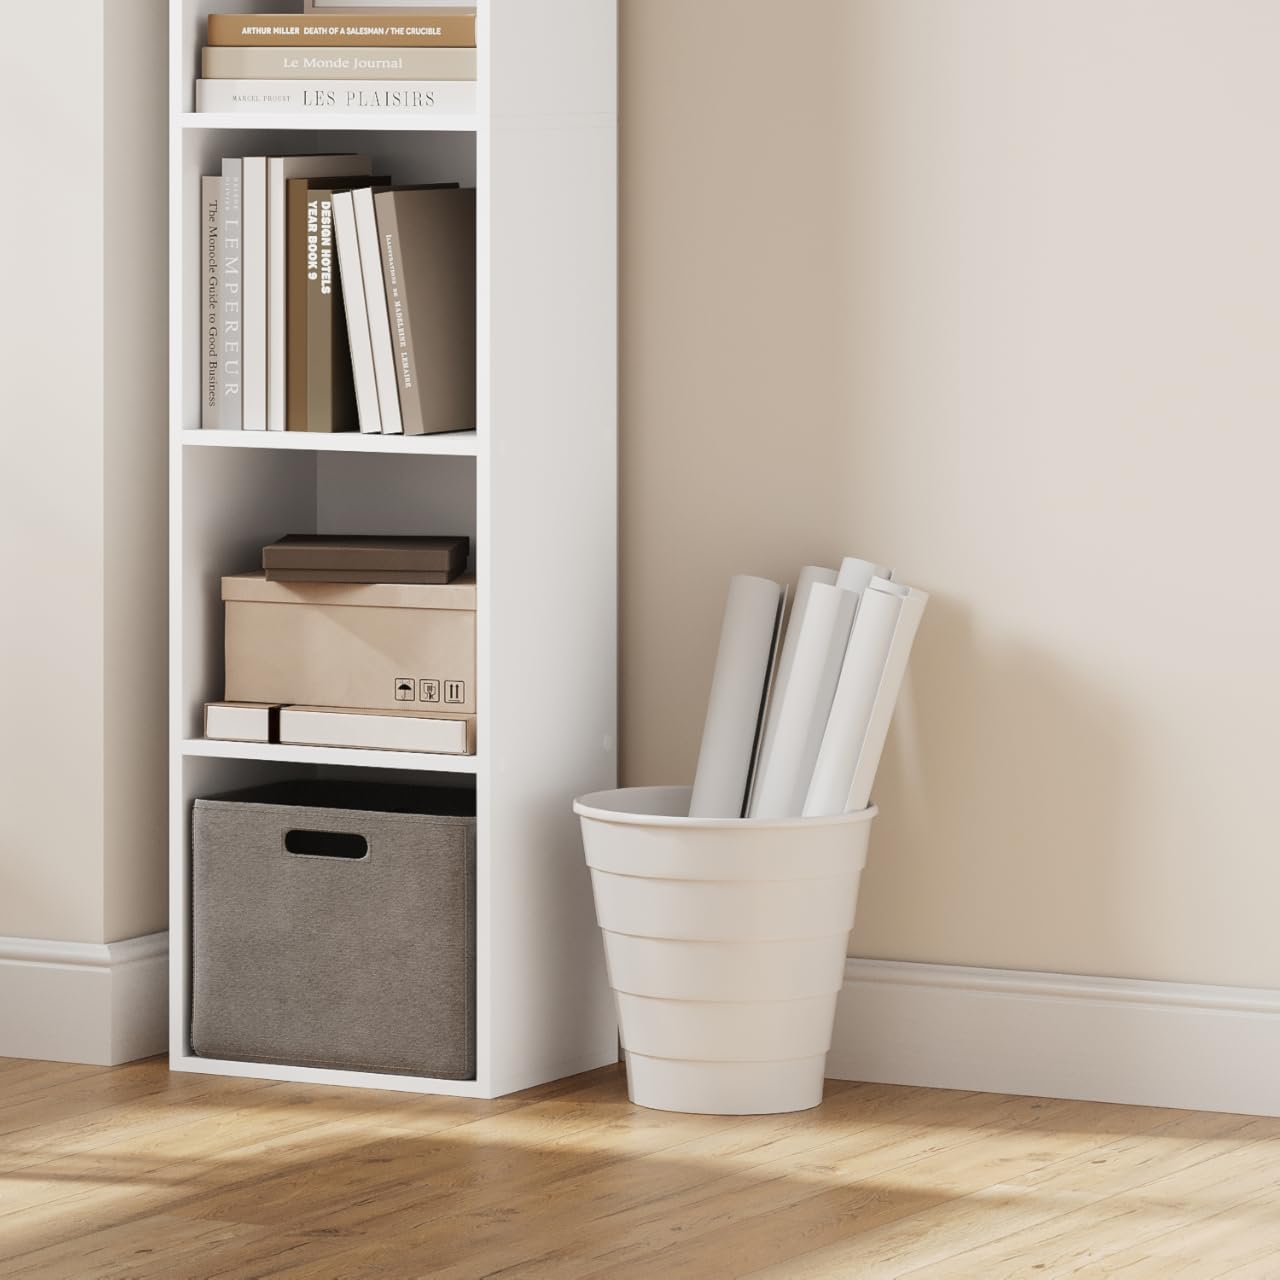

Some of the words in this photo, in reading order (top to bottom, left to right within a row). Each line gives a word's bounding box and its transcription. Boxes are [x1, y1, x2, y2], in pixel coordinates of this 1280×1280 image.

[242, 27, 271, 35] ARTHUR
[273, 27, 300, 35] MILLER
[303, 27, 328, 35] DEATH
[329, 27, 339, 35] OF
[339, 27, 346, 35] A
[346, 27, 384, 36] SALESMAN
[390, 27, 405, 36] THE
[405, 27, 442, 36] CRUCIBLE
[283, 58, 299, 68] Le
[303, 58, 350, 69] Monde
[353, 58, 403, 69] Journal
[303, 90, 336, 107] LES
[346, 91, 435, 107] PLAISIRS
[208, 199, 218, 223] The
[307, 200, 318, 233] YEAR
[321, 201, 331, 246] DESIGN
[208, 226, 218, 272] Monocle
[307, 236, 318, 269] BOOK
[307, 272, 318, 280] 9
[321, 249, 331, 294] HOTELS
[208, 276, 218, 310] Guide
[224, 220, 239, 395] LEMPEREUR
[208, 313, 216, 324] to
[208, 326, 218, 357] Good
[208, 360, 218, 408] Business
